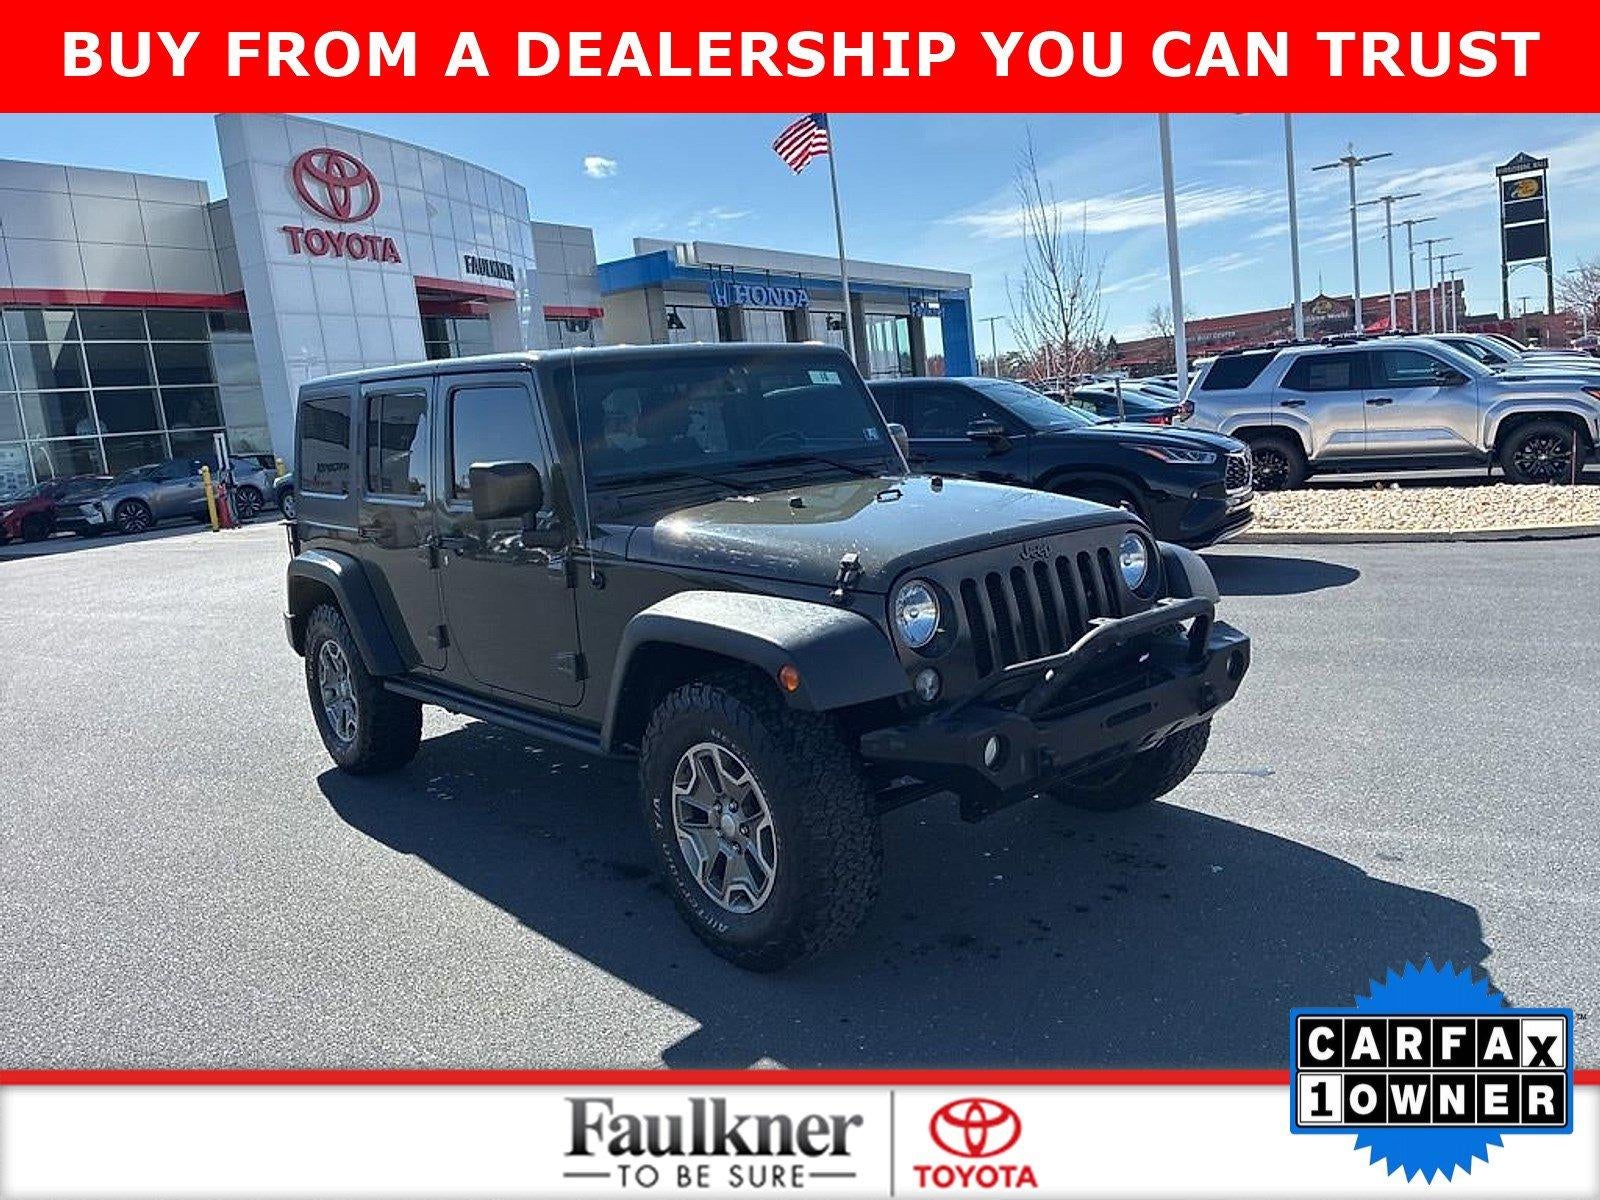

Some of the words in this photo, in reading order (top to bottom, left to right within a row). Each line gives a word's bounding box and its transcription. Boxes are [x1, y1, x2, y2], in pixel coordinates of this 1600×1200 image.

[283, 226, 402, 263] TOYOTA
[734, 284, 810, 307] HONDA
[1019, 542, 1050, 560] Jeep
